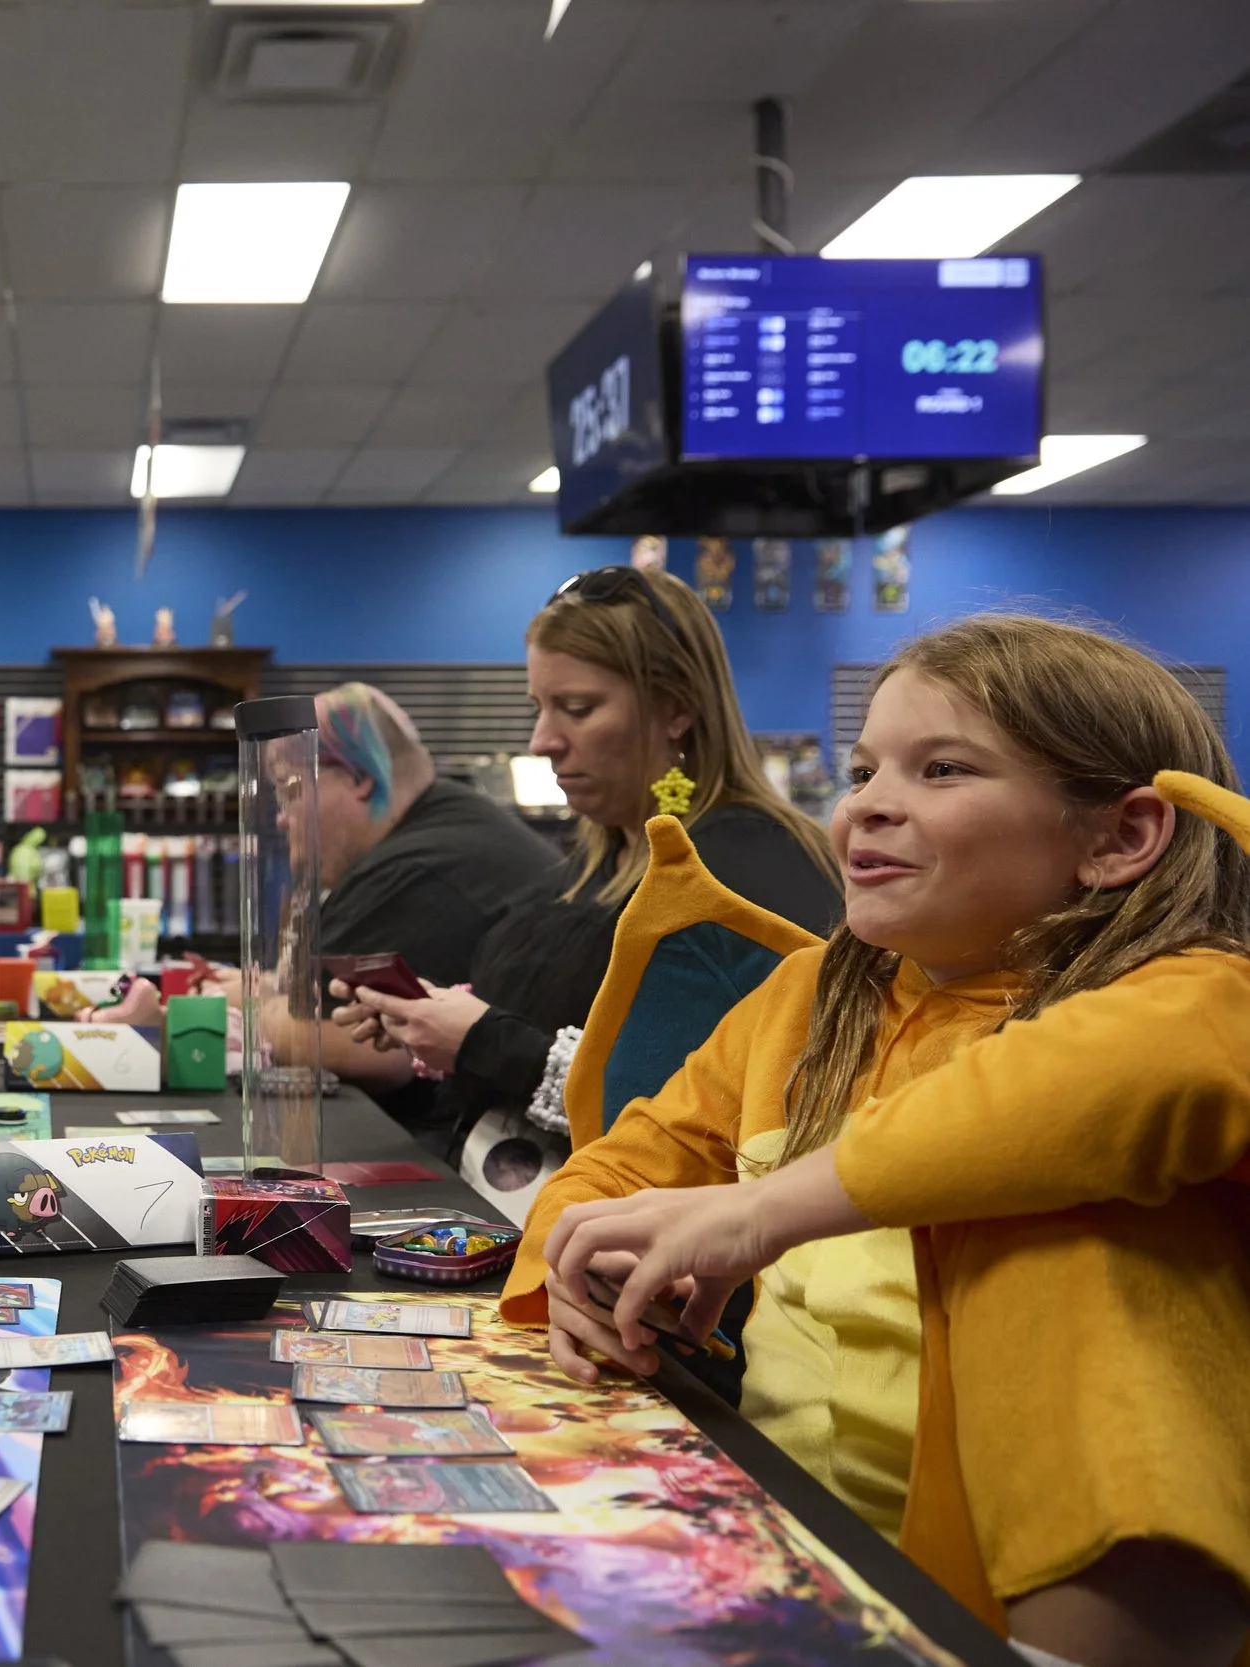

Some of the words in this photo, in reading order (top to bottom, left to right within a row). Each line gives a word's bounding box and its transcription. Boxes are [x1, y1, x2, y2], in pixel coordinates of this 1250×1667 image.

[902, 339, 998, 374] 06:22
[113, 1048, 130, 1075] 6
[133, 1180, 175, 1231] 7
